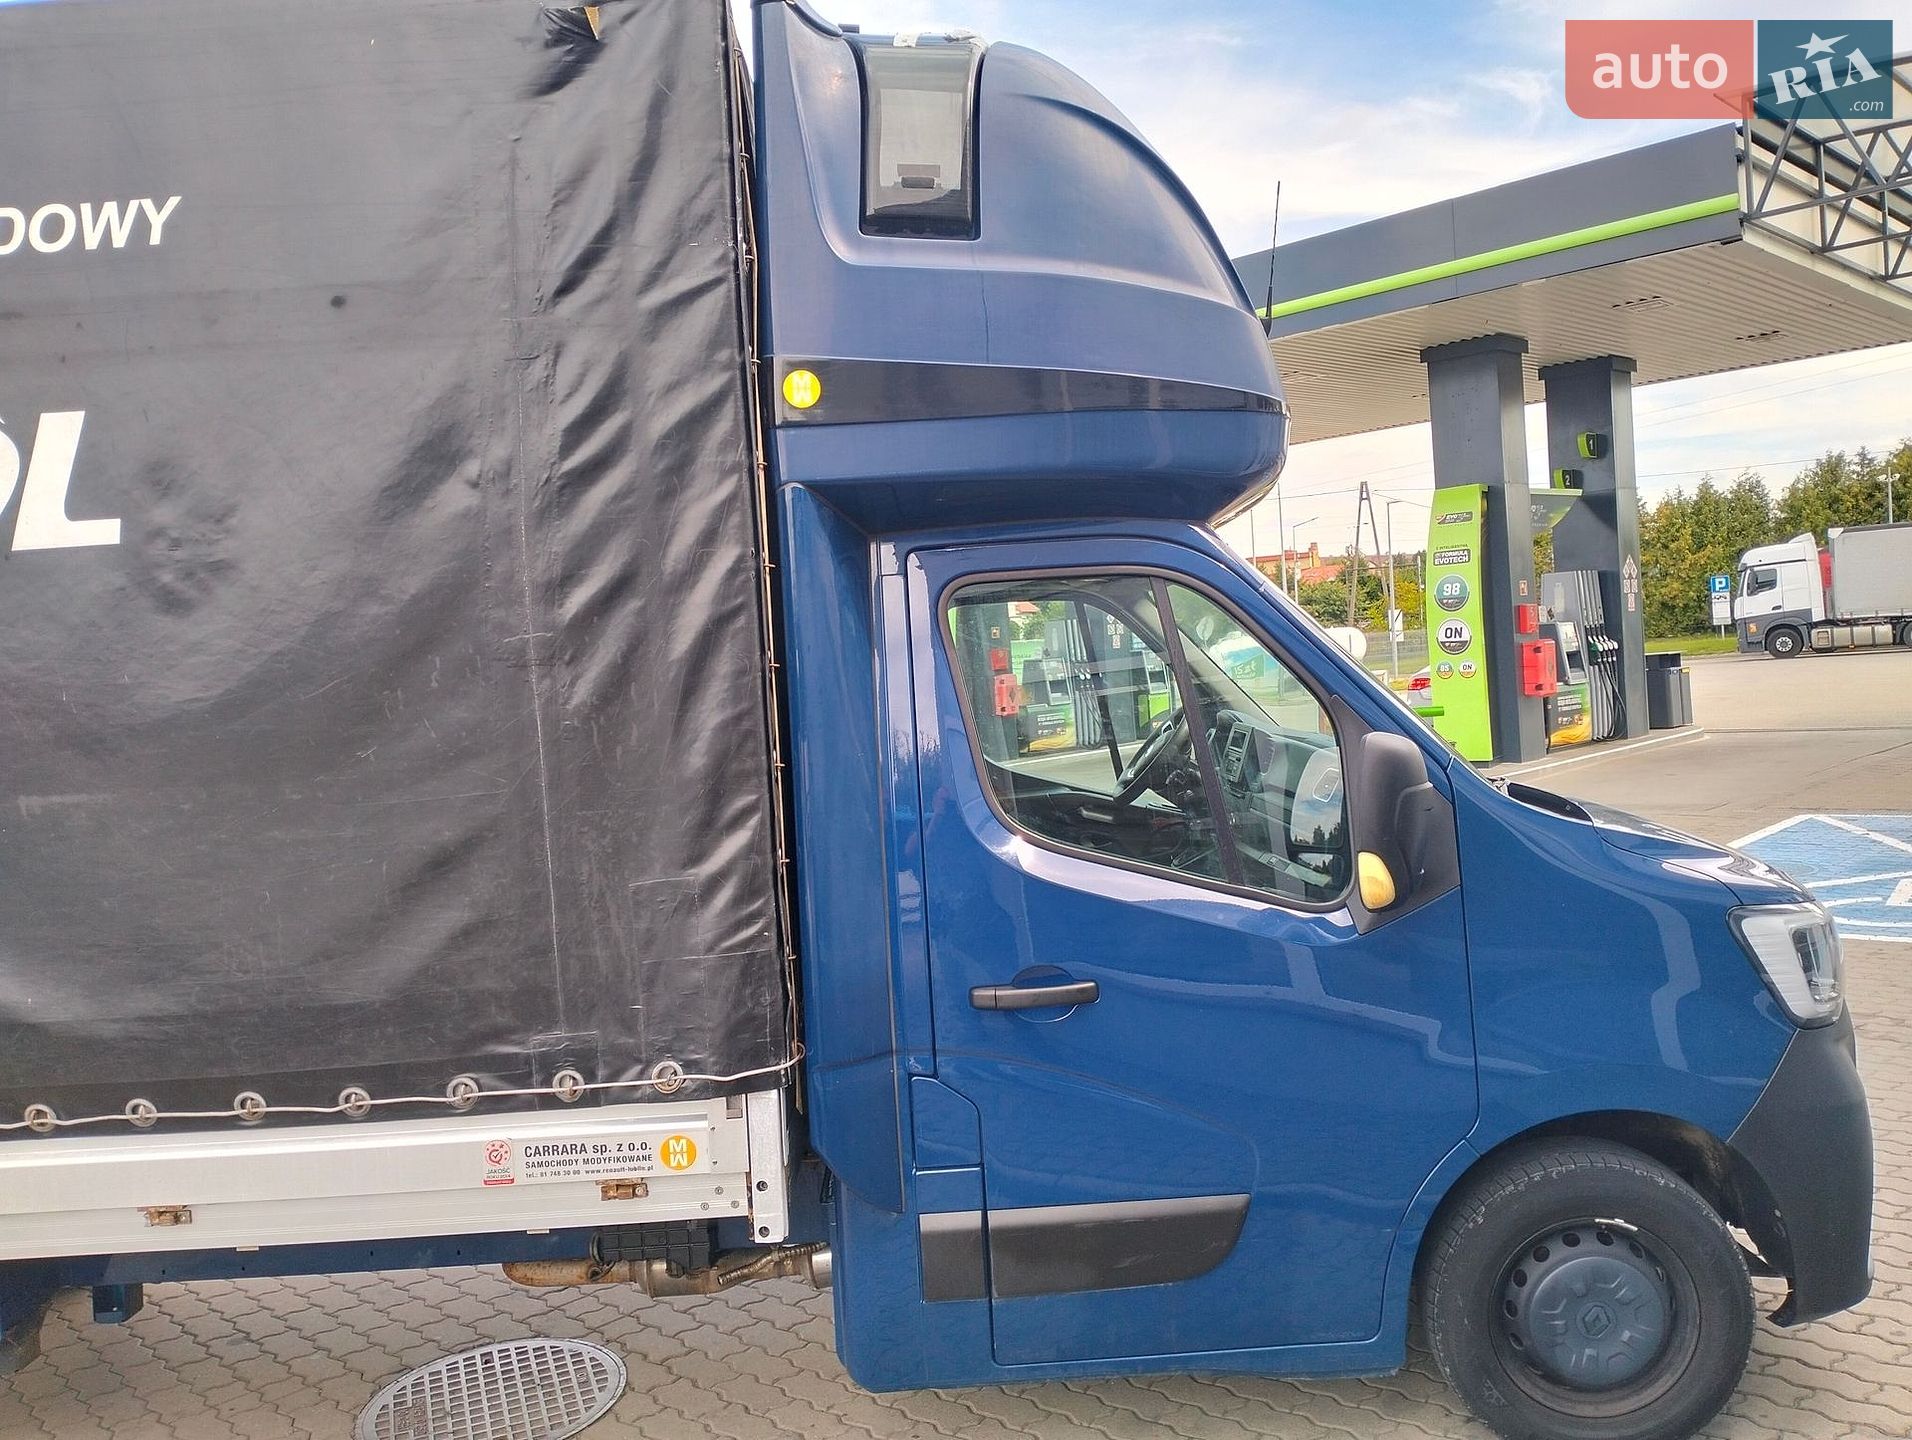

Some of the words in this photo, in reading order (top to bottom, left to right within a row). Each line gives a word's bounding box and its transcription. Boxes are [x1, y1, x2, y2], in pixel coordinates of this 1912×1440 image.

[0, 410, 121, 551] L
[1564, 475, 1570, 485] 2
[1434, 555, 1469, 565] EVOTECH
[1443, 583, 1460, 596] 98
[1715, 578, 1726, 592] P
[1444, 626, 1463, 639] ON
[524, 1142, 588, 1158] CARRARA
[592, 1144, 612, 1155] sp.
[616, 1143, 624, 1152] z
[628, 1142, 652, 1151] o.o.
[525, 1159, 579, 1169] SAMOCHODY
[582, 1154, 653, 1165] MODYFIKOWANE
